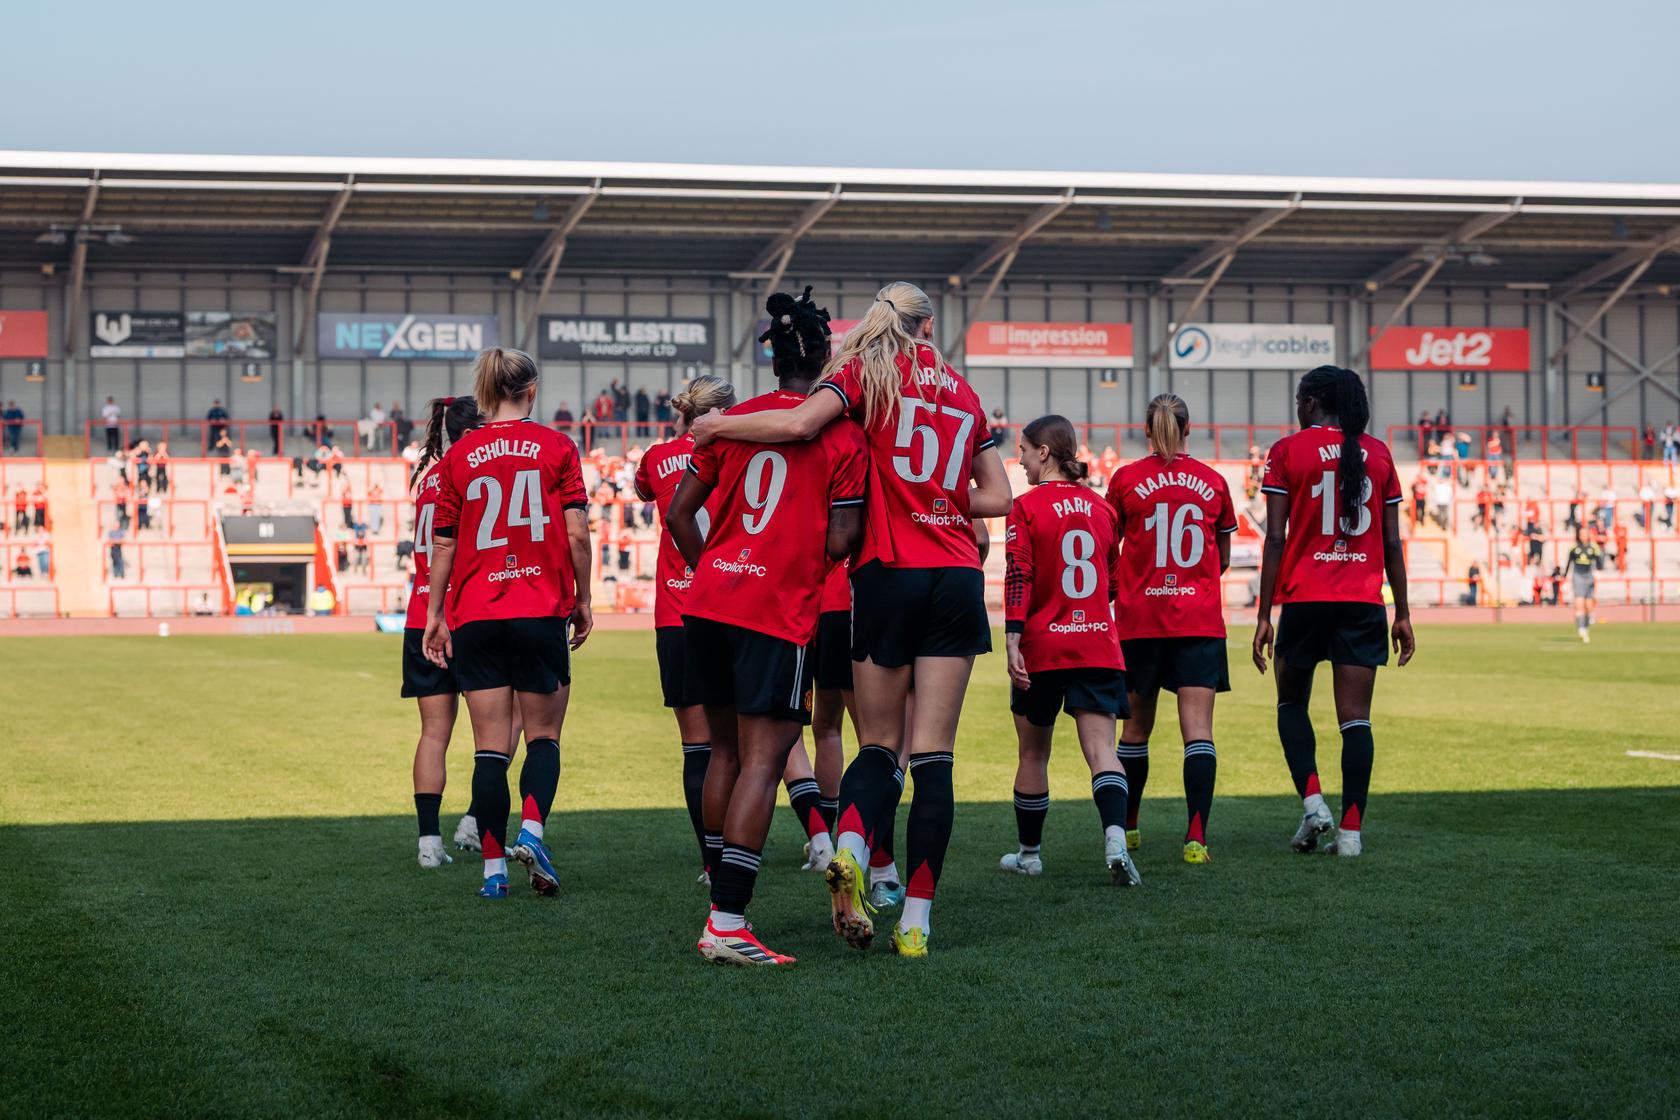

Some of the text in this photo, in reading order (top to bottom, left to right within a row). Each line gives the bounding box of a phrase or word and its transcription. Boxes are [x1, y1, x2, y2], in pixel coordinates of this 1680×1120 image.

[335, 314, 483, 358] NEXGEN
[549, 321, 708, 345] PAUL LESTER
[580, 343, 678, 357] TRANSPORT LTD
[1008, 325, 1109, 347] impression
[1405, 331, 1493, 366] Jet2
[916, 367, 959, 394] DRRY
[466, 438, 541, 469] SCHÜLLER
[892, 396, 976, 491] 57
[742, 450, 787, 535] 9
[1134, 471, 1215, 502] NAALSUND
[466, 469, 550, 551] 24
[1052, 496, 1093, 518] PARK
[415, 503, 435, 569] 4
[1144, 502, 1205, 569] 16
[1061, 529, 1098, 599] 8
